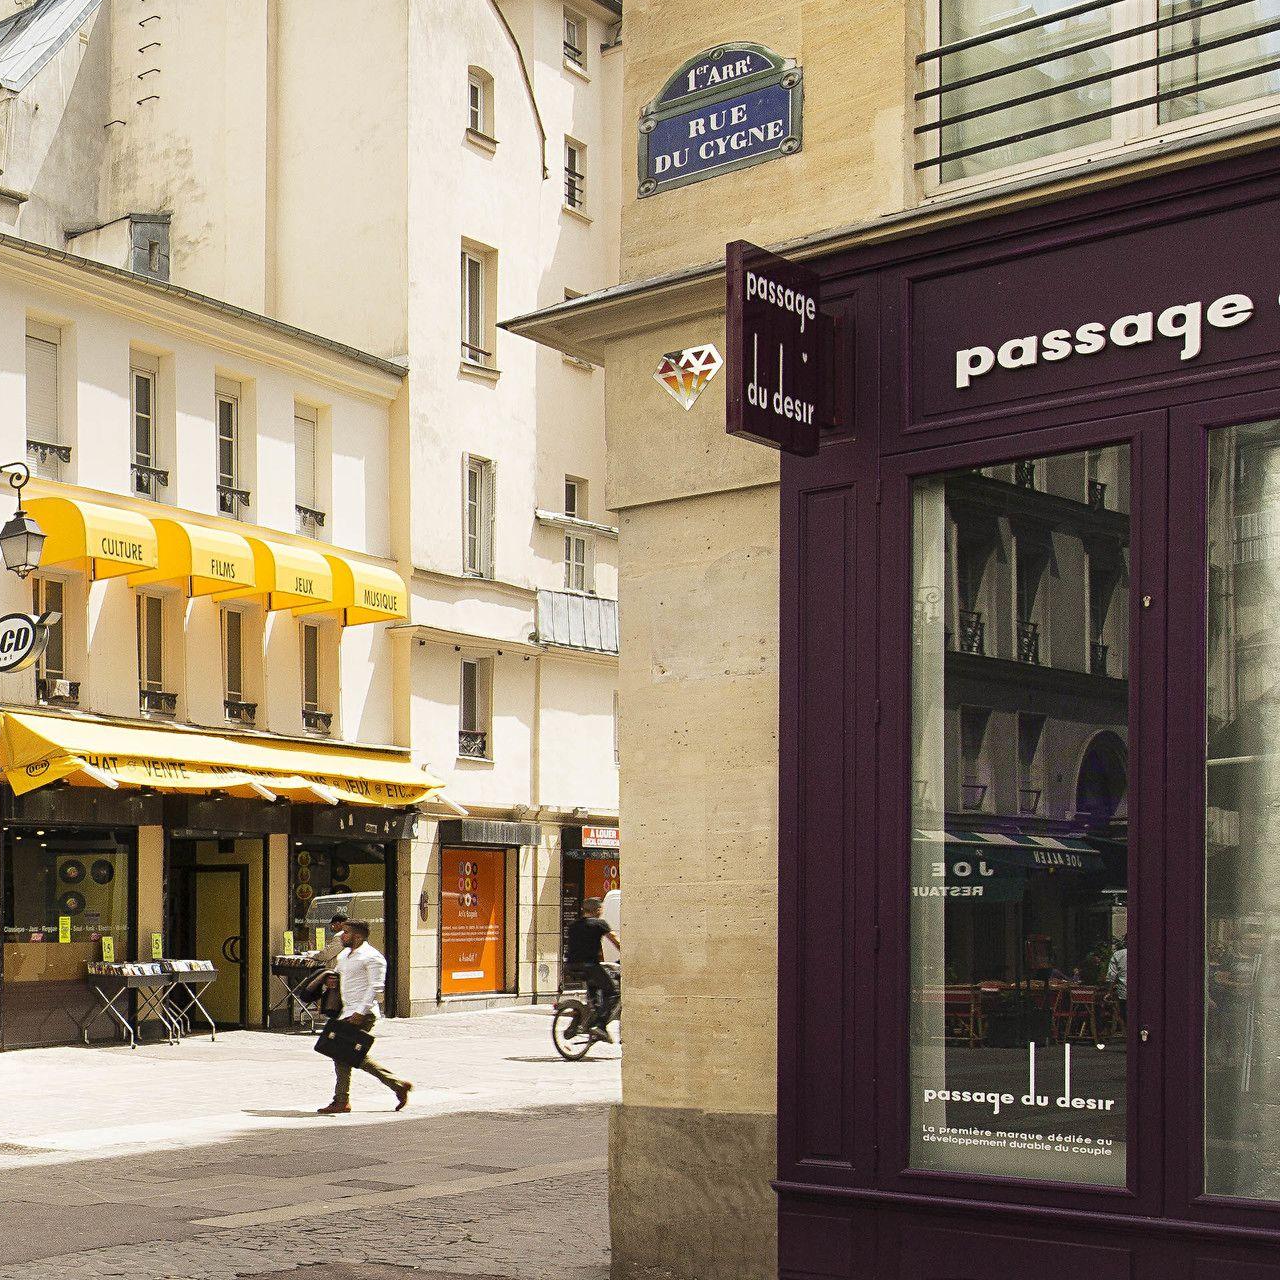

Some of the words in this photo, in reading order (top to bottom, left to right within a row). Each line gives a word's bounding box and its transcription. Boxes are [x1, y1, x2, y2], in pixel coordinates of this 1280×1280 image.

[688, 103, 748, 139] RUE
[654, 148, 690, 174] DU
[699, 119, 784, 160] CYGNE
[746, 271, 816, 333] passage
[955, 293, 1255, 388] passage
[747, 332, 768, 410] du
[101, 537, 143, 561] CULTURE
[210, 558, 236, 579] FILMS
[294, 576, 314, 595] JEUX
[363, 588, 398, 612] MUSIQUE
[28, 761, 48, 774] OCD
[142, 760, 190, 779] VENTE
[345, 779, 371, 796] JEUX
[923, 1088, 1015, 1115] passage
[1021, 1041, 1049, 1107] du
[922, 1124, 935, 1133] La
[939, 1126, 992, 1137] première
[996, 1131, 1043, 1141] marque
[1047, 1132, 1092, 1145] dédiée
[1096, 1138, 1113, 1146] au
[922, 1133, 1007, 1148] développement
[1009, 1139, 1052, 1152] durable
[1054, 1143, 1069, 1153] du
[1072, 1145, 1112, 1157] couple
